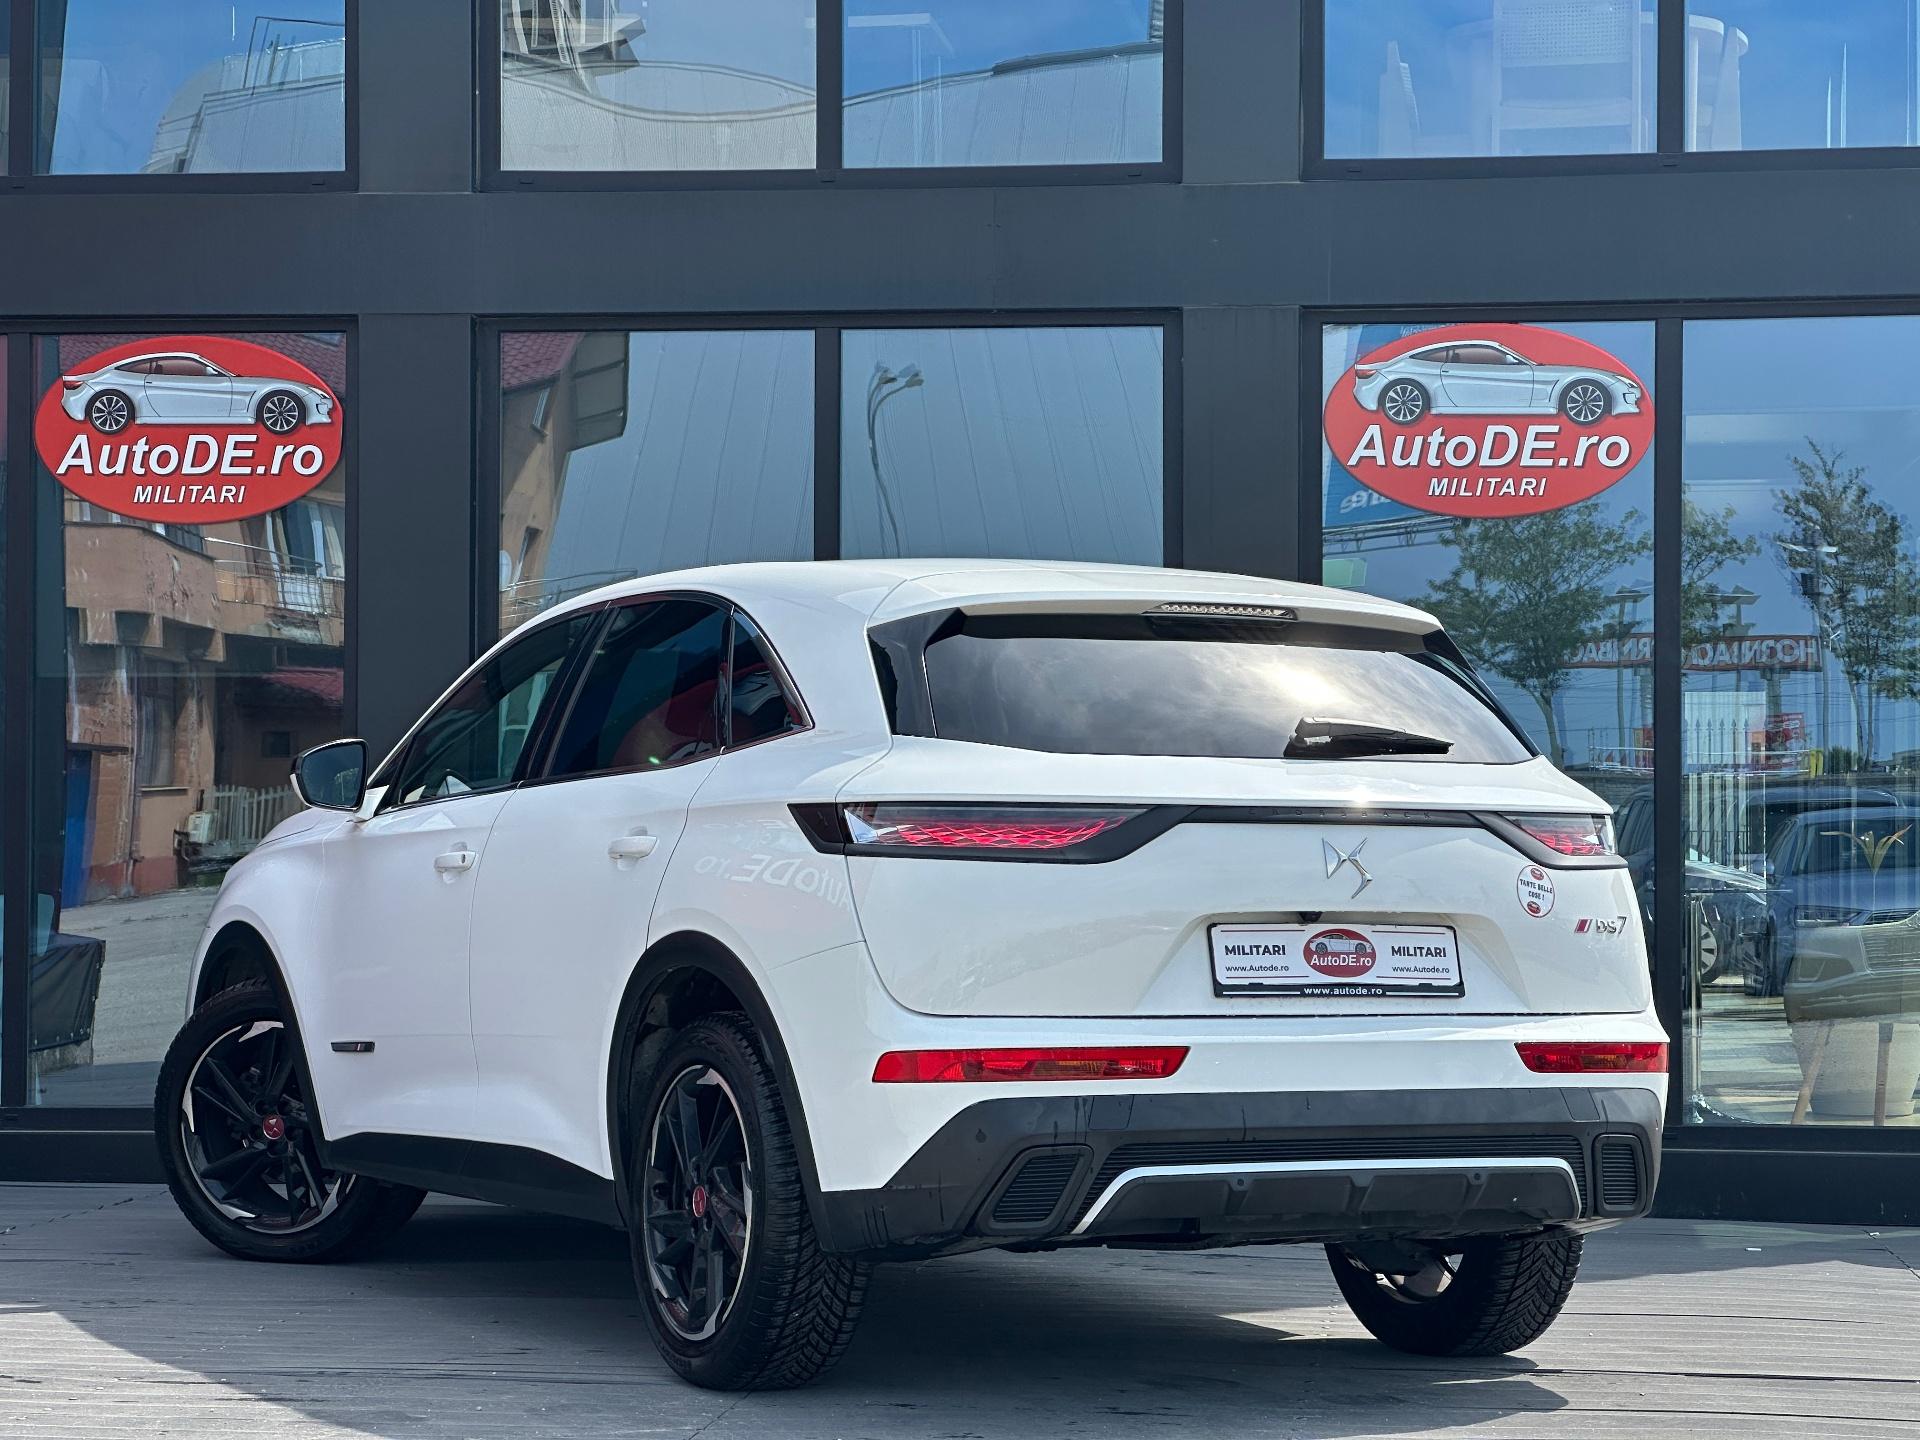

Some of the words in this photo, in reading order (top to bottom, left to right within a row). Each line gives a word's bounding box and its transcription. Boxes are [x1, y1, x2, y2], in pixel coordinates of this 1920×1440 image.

[1347, 424, 1631, 467] AutoDE.ro
[56, 434, 323, 476] AutoDE.ro
[1428, 478, 1547, 497] MILITARI
[133, 485, 245, 504] MILITARI
[1537, 884, 1553, 894] BELLE
[1224, 944, 1286, 956] MILITARI
[1391, 945, 1447, 958] MILITARI
[1310, 953, 1373, 967] AutoDE.ro
[1225, 964, 1290, 973] www.Autode.ro
[1391, 965, 1450, 974] www.Autode.ro
[1303, 985, 1383, 995] www.autode.ro
